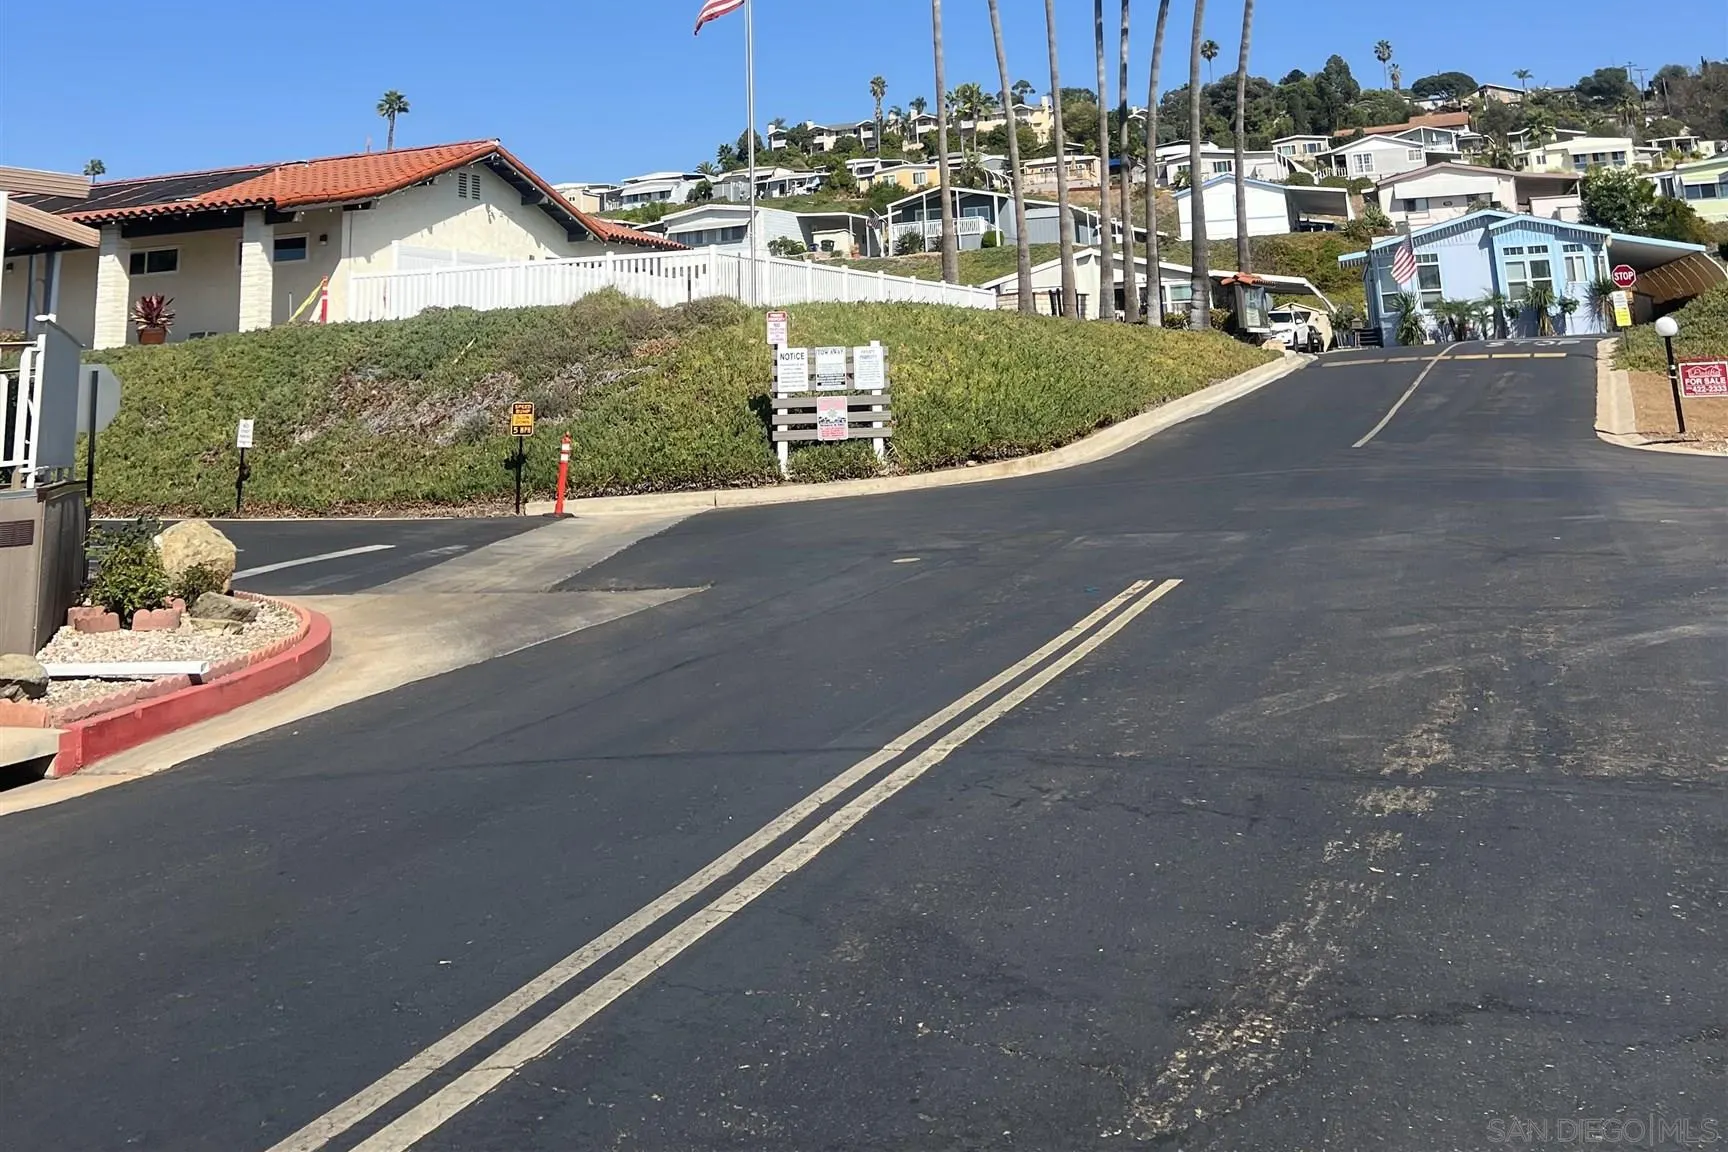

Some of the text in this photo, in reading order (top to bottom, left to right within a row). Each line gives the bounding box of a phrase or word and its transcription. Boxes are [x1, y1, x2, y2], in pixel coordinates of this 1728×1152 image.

[1614, 271, 1633, 280] STOP
[780, 352, 804, 360] NOTICE
[1703, 377, 1726, 385] SALE
